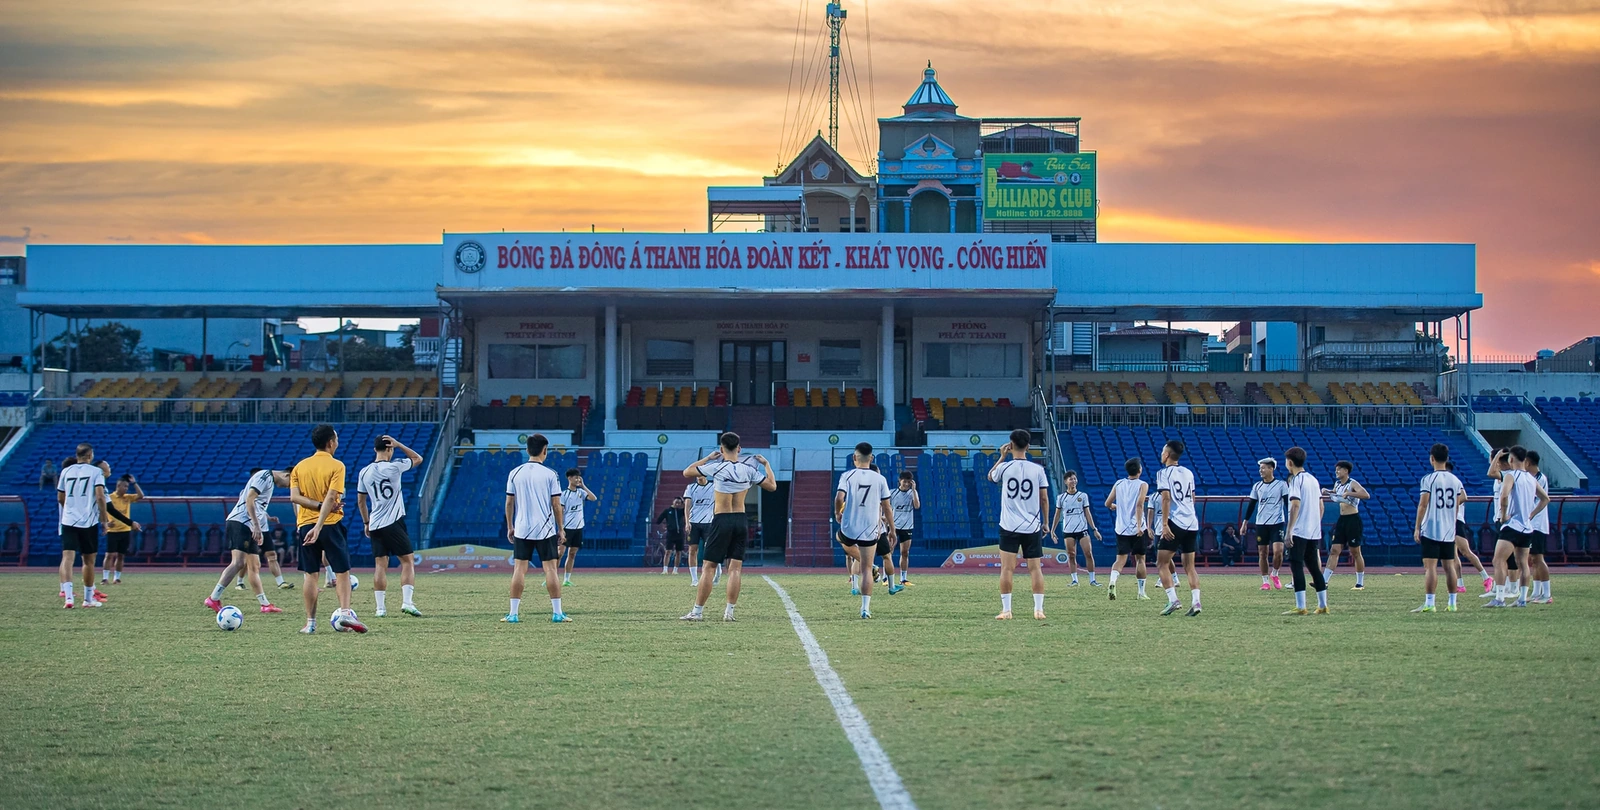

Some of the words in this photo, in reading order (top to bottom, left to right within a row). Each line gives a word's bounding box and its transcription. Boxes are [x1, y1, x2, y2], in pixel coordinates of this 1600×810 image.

[987, 168, 1055, 208] BILLIARDS
[1060, 188, 1092, 208] CLUB
[497, 240, 545, 269] BÓNG
[550, 239, 575, 269] ĐÁ
[578, 241, 626, 270] ĐÔNG
[629, 240, 642, 269] Á
[644, 245, 701, 269] THANH
[705, 240, 742, 269] HÓA
[747, 240, 793, 269] ĐOÀN
[798, 239, 831, 269] KẾT
[845, 240, 892, 269] KHÁT
[896, 245, 944, 272] VỌNG
[956, 239, 1004, 270] CỐNG
[1006, 239, 1047, 269] HIẾN
[66, 477, 91, 497] 77
[370, 478, 394, 502] 16
[858, 485, 872, 507] 7
[1007, 477, 1033, 500] 99
[1173, 480, 1192, 502] 34
[1436, 487, 1455, 509] 33
